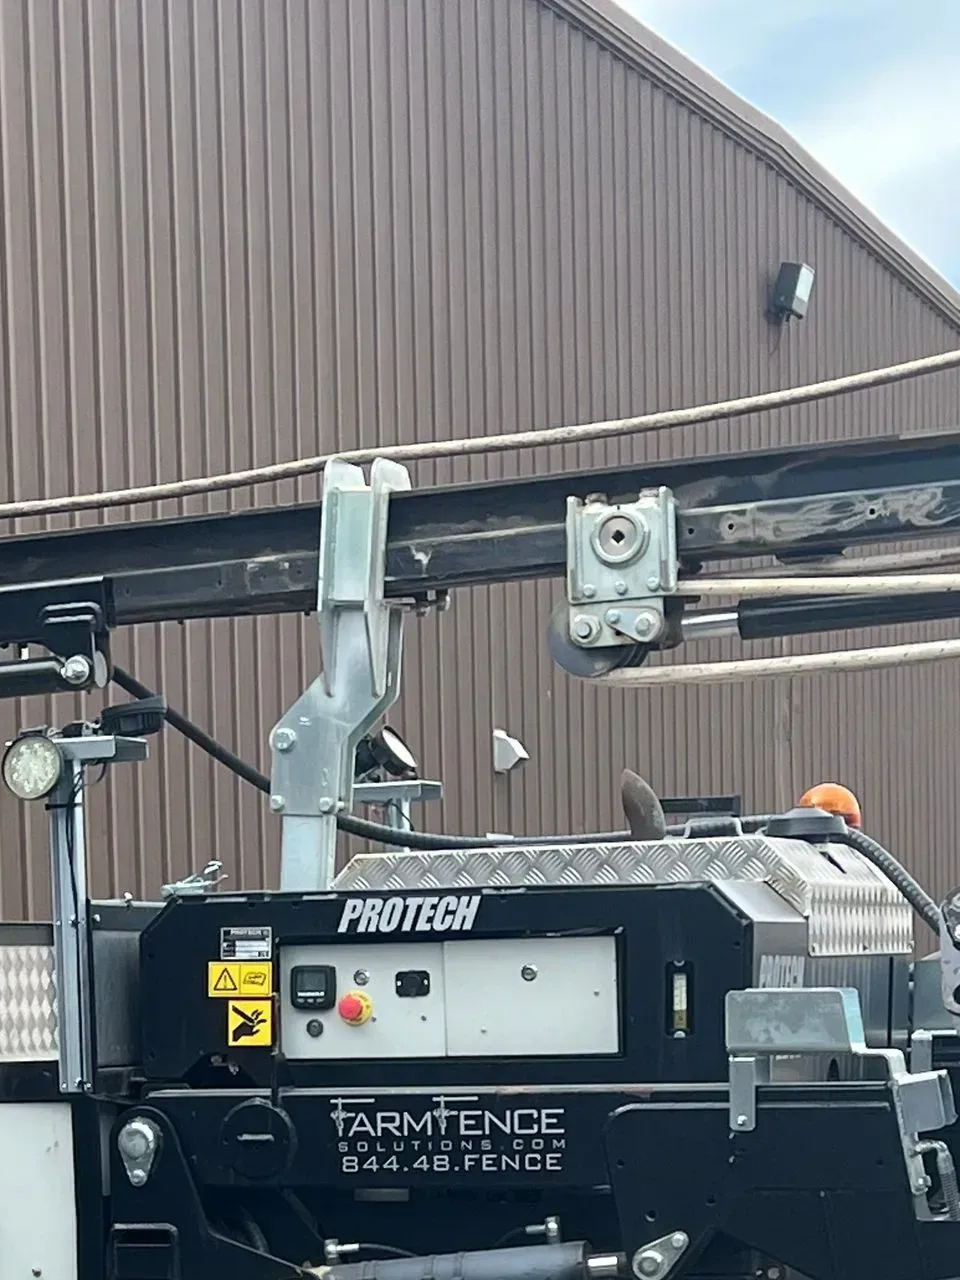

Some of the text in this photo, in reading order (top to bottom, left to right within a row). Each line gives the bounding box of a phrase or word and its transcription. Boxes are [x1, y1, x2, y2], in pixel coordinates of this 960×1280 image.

[337, 895, 482, 933] PROTECH
[338, 1139, 566, 1152] SOLUTIONS.COM
[342, 1153, 562, 1173] 844.48.FENCE
